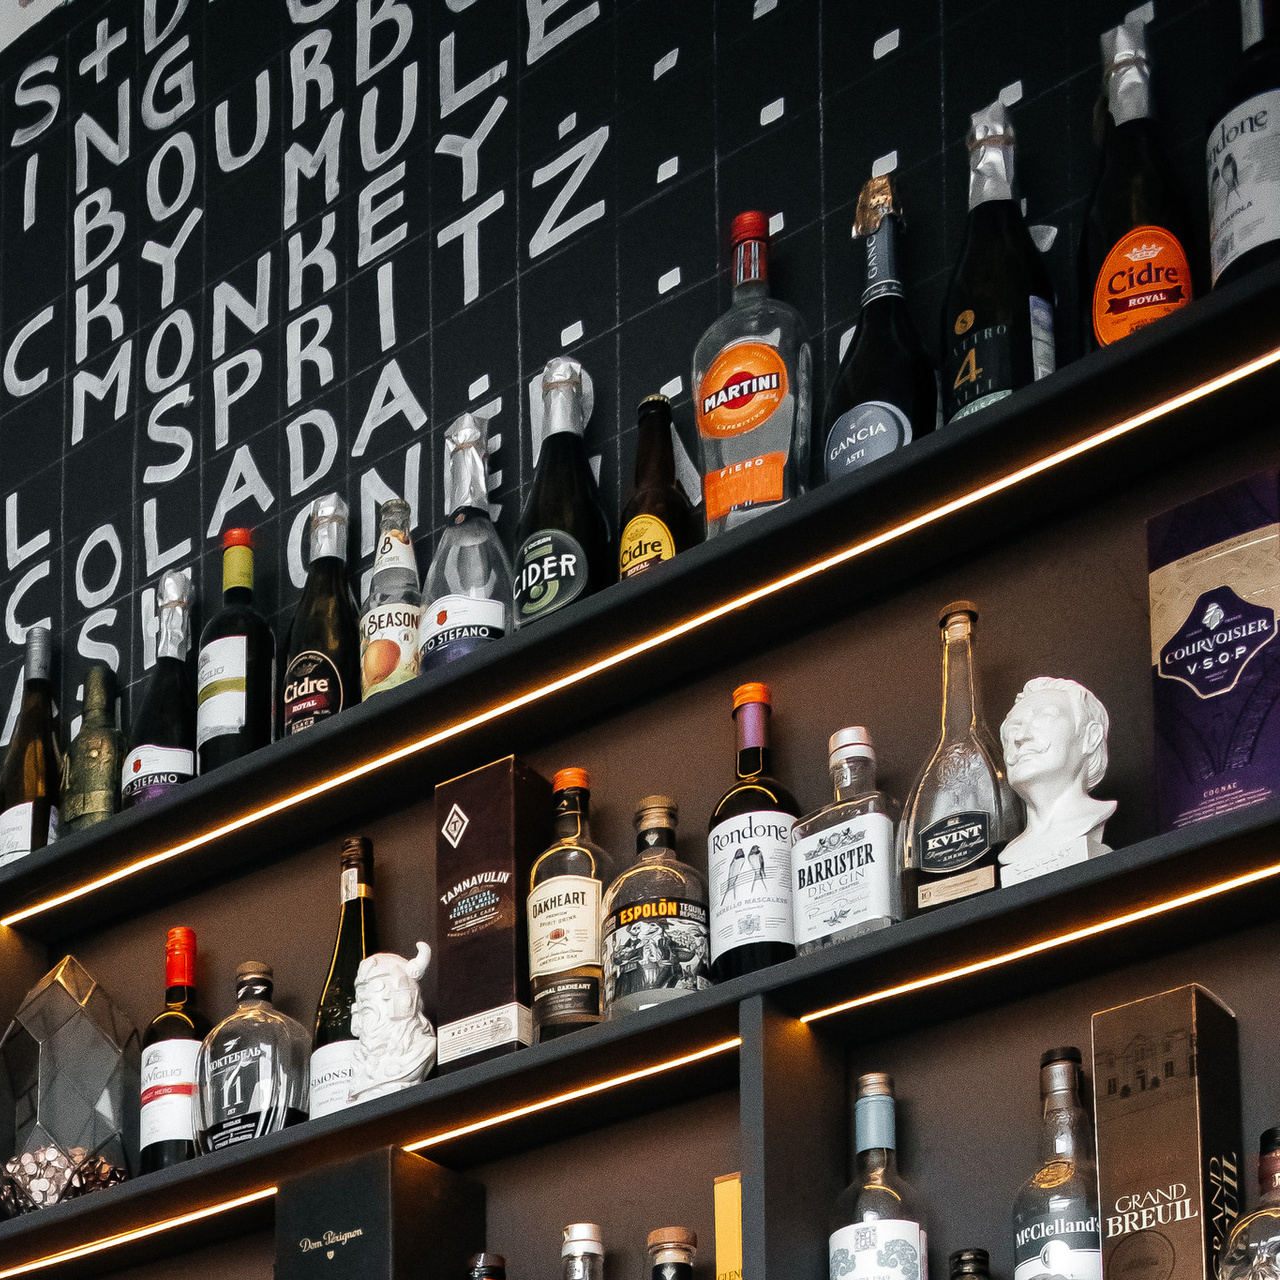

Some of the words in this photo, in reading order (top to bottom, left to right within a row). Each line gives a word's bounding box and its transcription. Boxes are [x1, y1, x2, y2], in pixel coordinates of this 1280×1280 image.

[284, 0, 601, 231] MULE
[74, 0, 480, 281] BOURB
[71, 96, 509, 446] MONKEY
[1108, 261, 1179, 295] Cidre
[142, 126, 610, 484] SPRITZ
[1128, 293, 1167, 308] ROYAL
[704, 373, 778, 414] MARTINI
[830, 421, 887, 461] GANCIA
[720, 458, 764, 478] FIERO
[845, 448, 866, 466] ASTI
[4, 358, 428, 646] COLADA
[621, 539, 663, 568] Cidre
[513, 554, 577, 600] CIDER
[437, 626, 490, 645] STEFANO
[1164, 618, 1271, 665] COURVOISIER
[284, 676, 330, 704] Cidre
[292, 699, 318, 714] ROYAL
[129, 774, 178, 791] STEFANO
[1203, 781, 1238, 798] COGNAC
[711, 815, 789, 855] Rondone
[926, 824, 983, 851] KVINT
[797, 842, 876, 891] BARRISTER
[440, 870, 512, 906] TAMNAVULIN
[807, 879, 834, 898] DRY
[839, 868, 866, 886] GIN
[532, 891, 587, 919] OAKHEART
[679, 902, 706, 917] TEQUILA
[451, 1017, 502, 1037] SCOTLAND
[1114, 1183, 1187, 1214] GRAND
[1105, 1197, 1198, 1239] BREUIL
[299, 1237, 323, 1253] Dom
[322, 1228, 363, 1246] Pérignon
